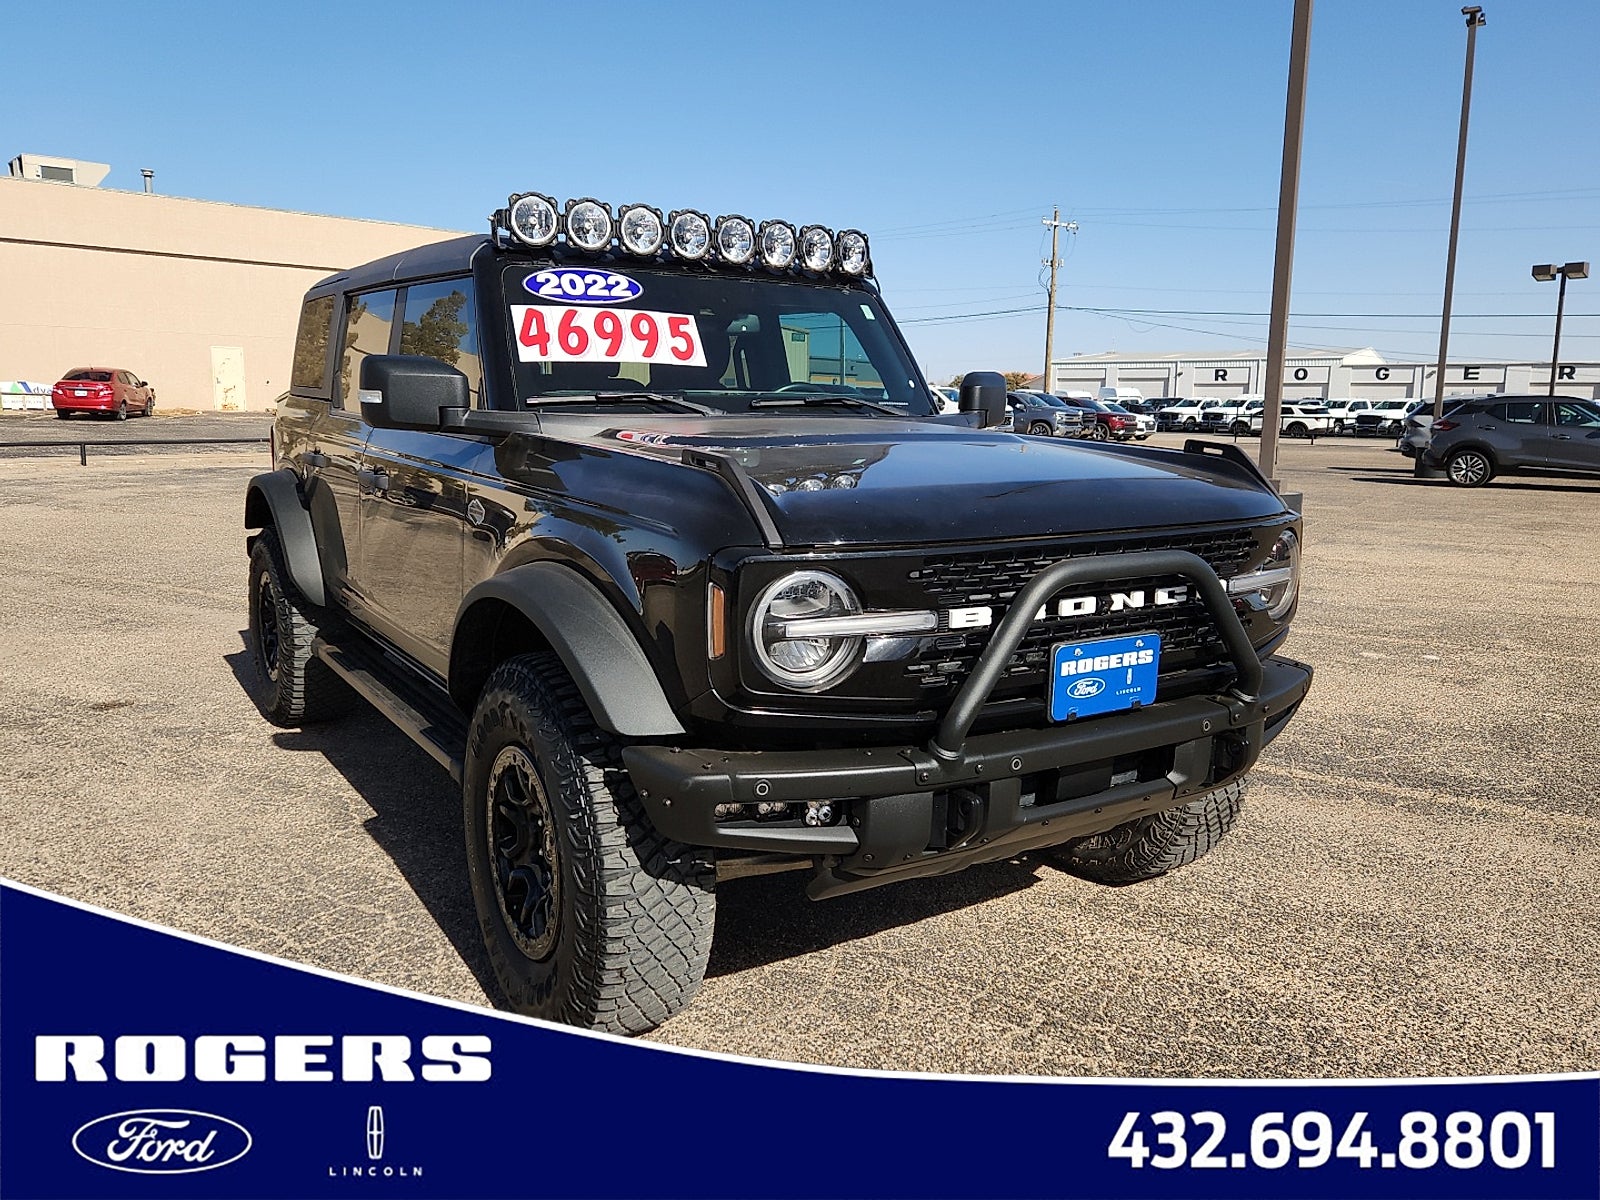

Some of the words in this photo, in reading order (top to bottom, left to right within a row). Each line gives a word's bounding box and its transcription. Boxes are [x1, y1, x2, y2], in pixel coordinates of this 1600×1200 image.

[535, 272, 632, 297] 2022
[519, 307, 694, 361] 46995
[949, 578, 1227, 629] BONC
[1060, 649, 1154, 677] ROGERS
[1073, 680, 1098, 696] Ford
